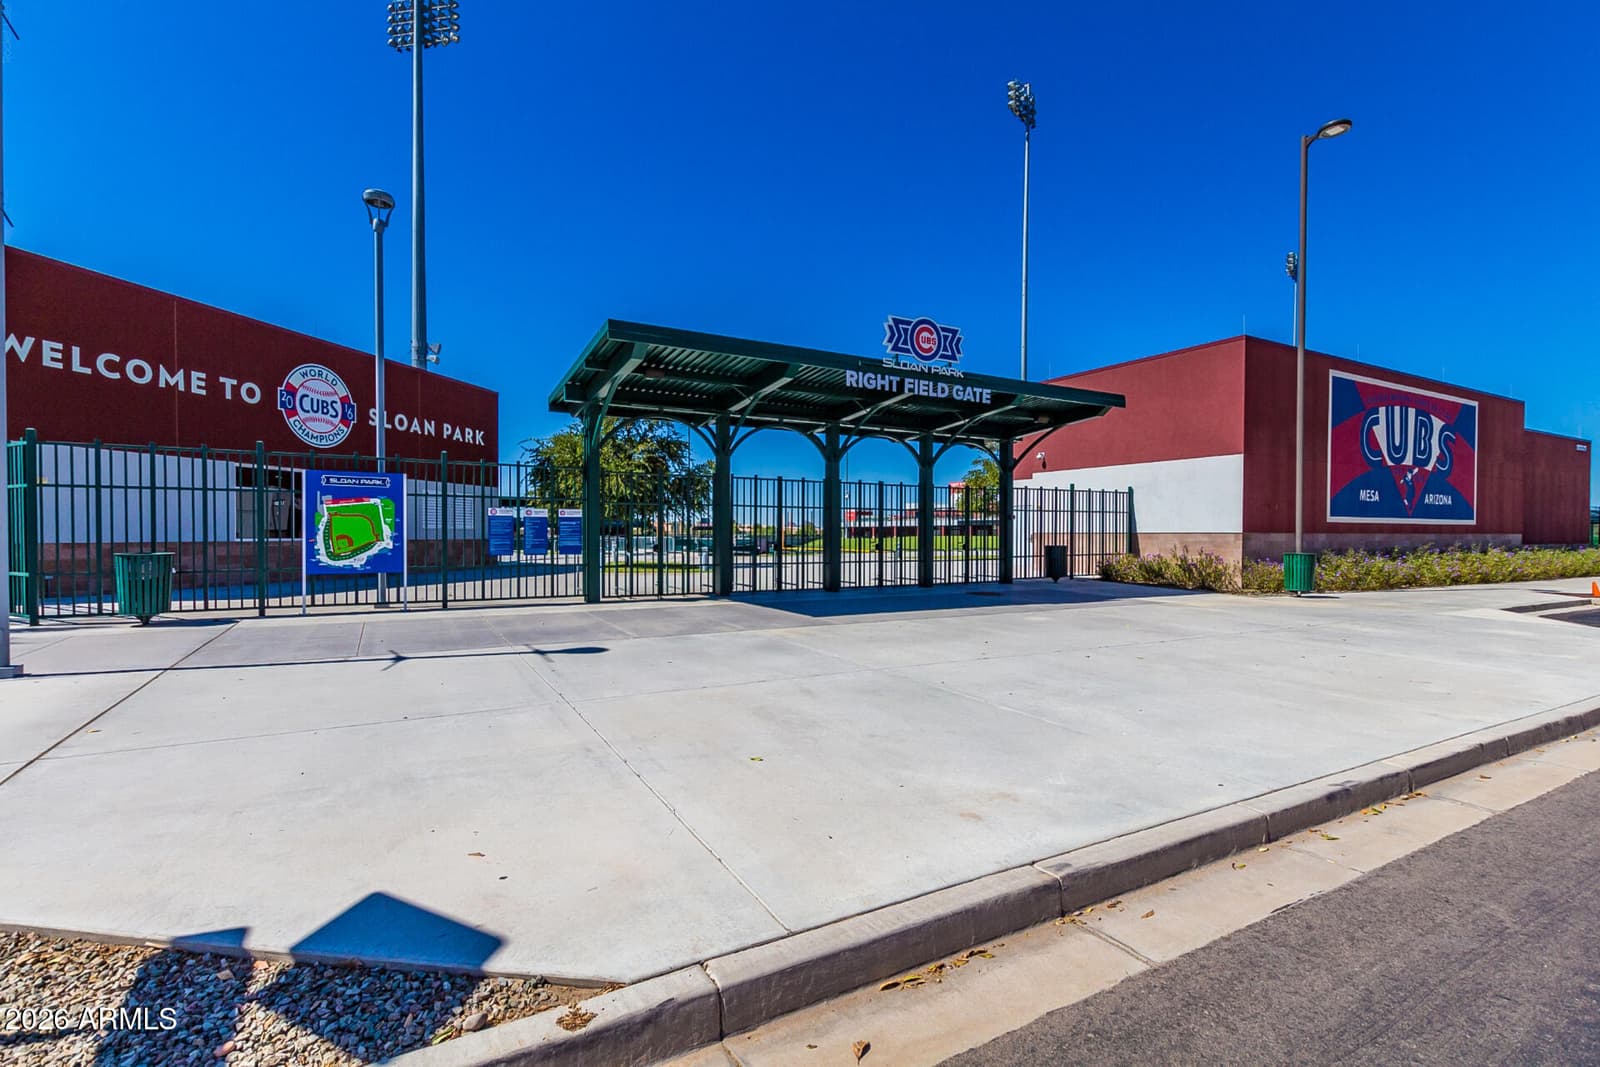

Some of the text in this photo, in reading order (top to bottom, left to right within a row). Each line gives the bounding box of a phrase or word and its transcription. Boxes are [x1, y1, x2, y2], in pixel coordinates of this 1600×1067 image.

[914, 325, 938, 355] CUBS
[5, 333, 262, 405] WELCOME TO
[299, 369, 338, 387] WORLD
[882, 357, 965, 379] SLOAN PARK
[845, 369, 992, 405] RIGHT FIELD GATE
[298, 393, 339, 419] CUBS
[293, 419, 345, 443] CHAMPIONS
[368, 408, 485, 446] SLOAN PARK
[1360, 405, 1456, 479] CUBS
[329, 477, 359, 485] SLOAN
[1359, 489, 1380, 503] MESA
[1424, 493, 1453, 506] ARIZONA
